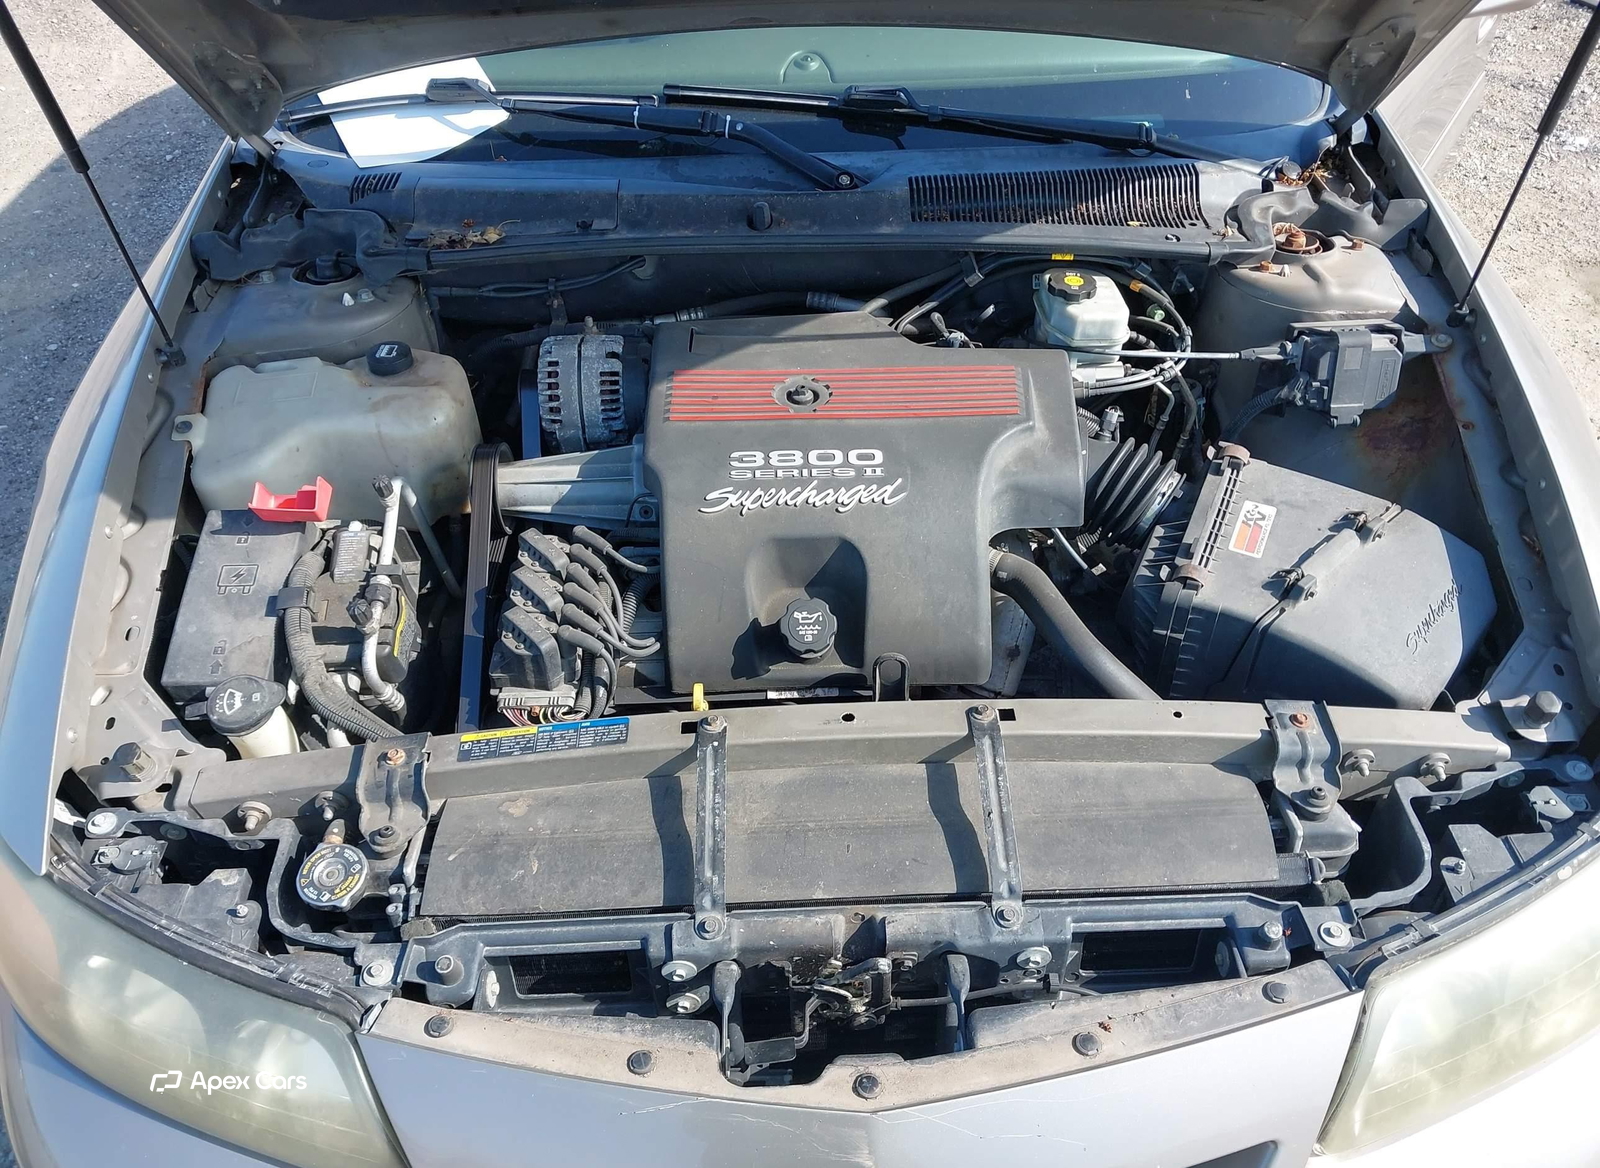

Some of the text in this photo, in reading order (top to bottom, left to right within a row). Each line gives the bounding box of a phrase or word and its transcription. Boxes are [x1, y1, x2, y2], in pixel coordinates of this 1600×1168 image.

[728, 448, 884, 467] 3800
[728, 467, 885, 480] SERIES II
[698, 477, 908, 517] Supercharged
[1241, 504, 1267, 529] K&N
